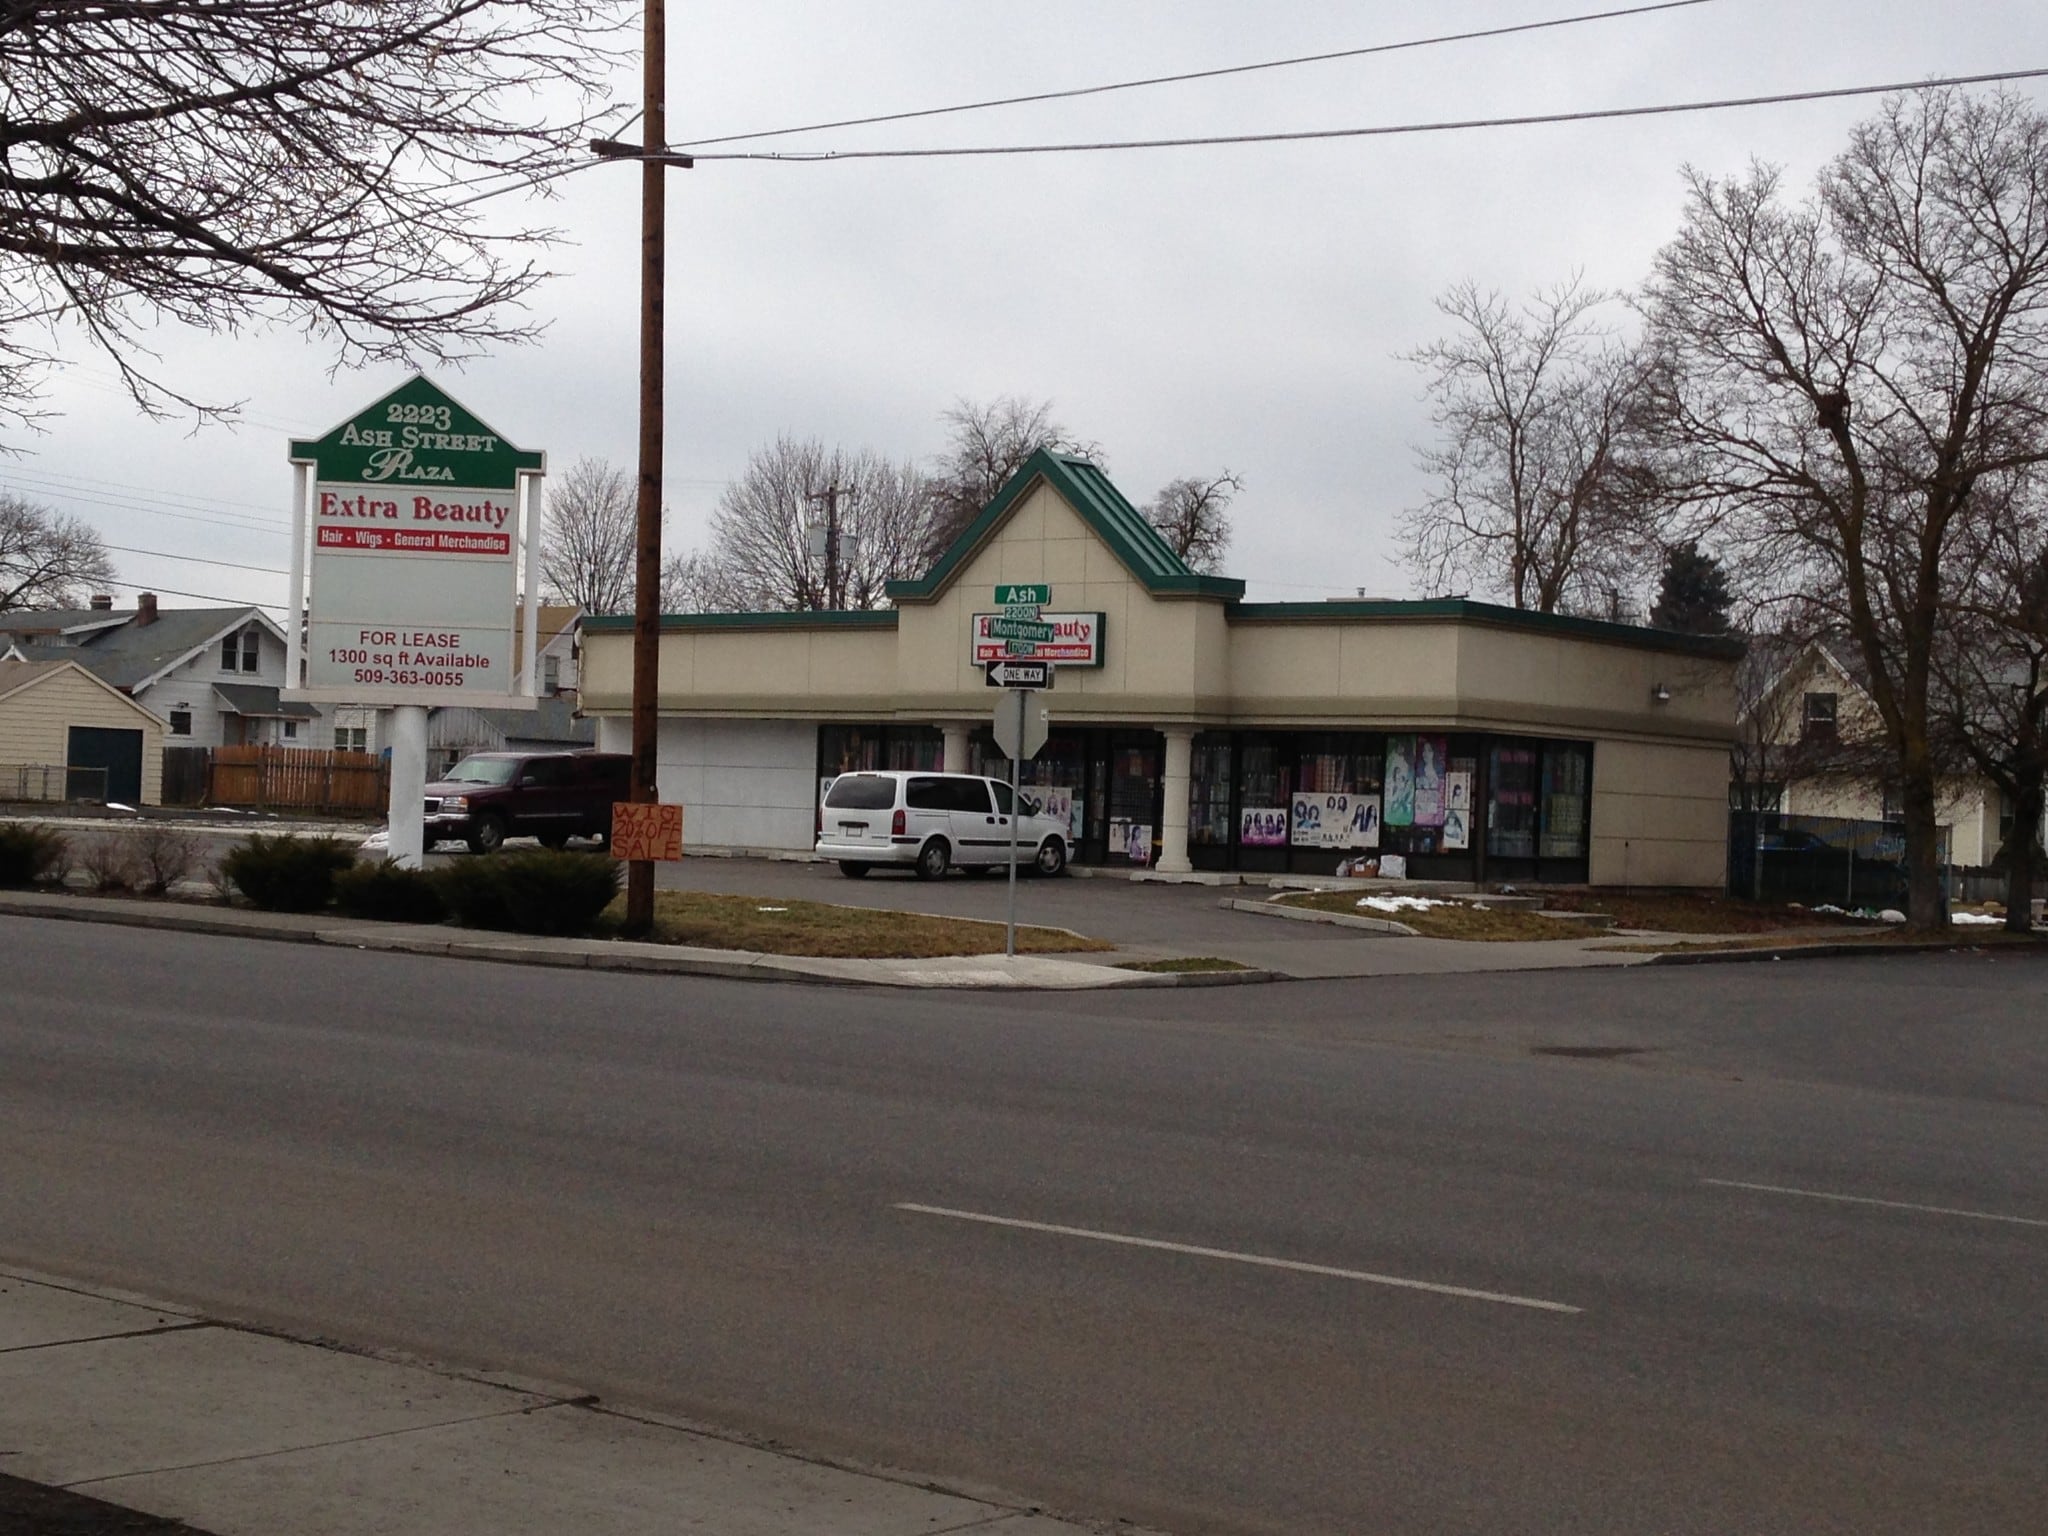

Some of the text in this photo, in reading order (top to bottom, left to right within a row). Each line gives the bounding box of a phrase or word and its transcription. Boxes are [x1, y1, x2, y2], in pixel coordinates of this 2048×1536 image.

[387, 403, 451, 431] 2223
[339, 423, 498, 452] ASH STREET
[361, 447, 455, 481] PLAZA
[320, 492, 510, 529] Extra Beauty
[321, 530, 506, 550] Hair Wigs General Merchandise
[1006, 587, 1036, 602] Ash
[1006, 607, 1035, 618] 2200N
[360, 631, 460, 648] FOR LEASE
[993, 618, 1054, 642] Montgomery
[1054, 619, 1091, 642] auty
[329, 649, 490, 668] 1300 sq ft Available
[354, 669, 464, 686] 509-363-0055
[1004, 669, 1041, 679] ONE WAY
[614, 805, 676, 820] WIG
[613, 839, 679, 860] SALE
